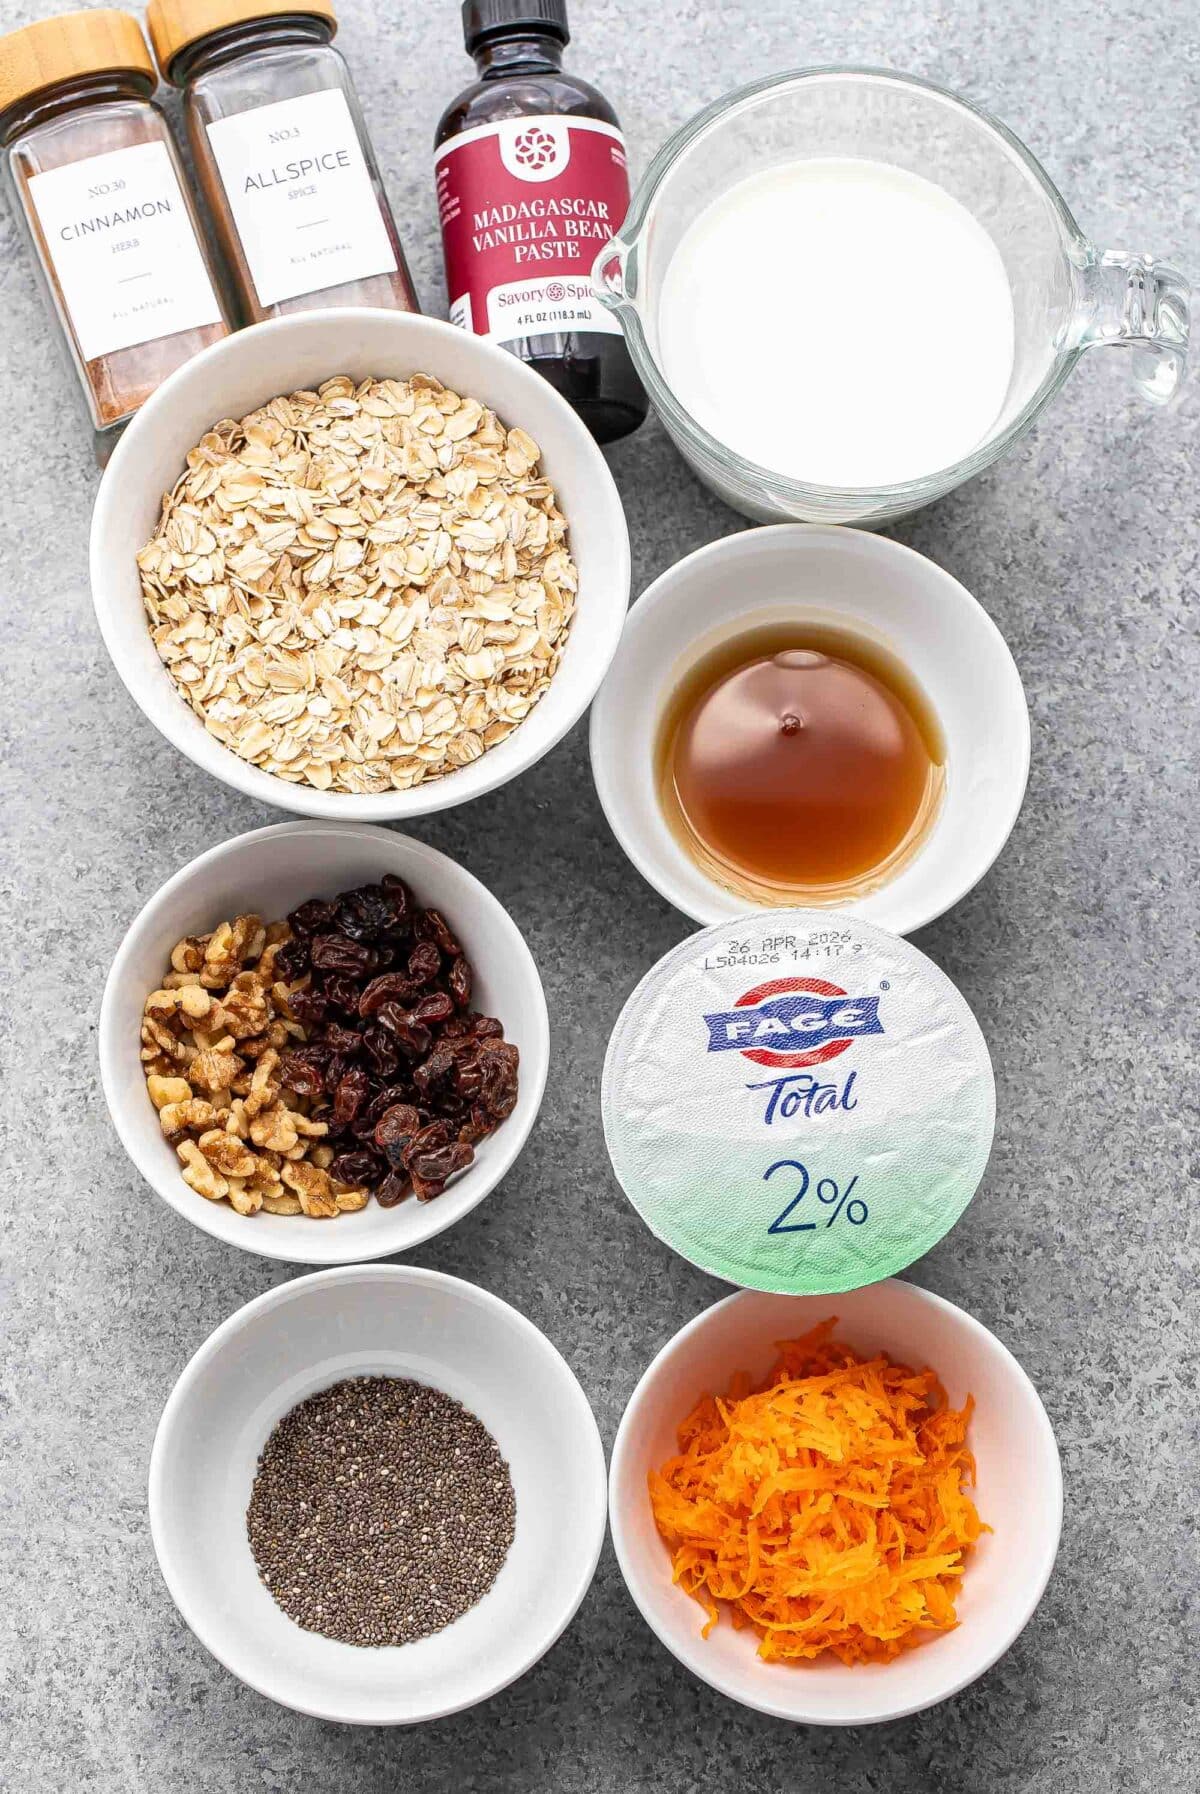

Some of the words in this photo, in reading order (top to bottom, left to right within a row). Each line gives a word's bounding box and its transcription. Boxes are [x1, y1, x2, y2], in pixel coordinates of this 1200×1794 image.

[268, 127, 301, 144] NO.3
[244, 150, 351, 193] ALLSPICE
[88, 179, 127, 198] NO.30
[287, 185, 318, 201] SPICE
[60, 199, 172, 241] CINNAMON
[473, 198, 609, 231] MADAGASCAR
[111, 238, 140, 253] HERB
[472, 220, 557, 252] VANILLA
[565, 220, 615, 240] BEAN
[513, 241, 580, 263] PASTE
[497, 288, 545, 308] Savory
[567, 283, 597, 301] Spic
[517, 315, 523, 325] 4
[525, 313, 534, 324] FL
[536, 310, 547, 322] OZ
[549, 309, 575, 321] (118.3
[577, 309, 592, 320] mL)
[728, 939, 751, 954] 26
[762, 935, 797, 951] APR
[808, 929, 852, 946] 2026
[704, 952, 781, 971] L504026
[792, 944, 844, 961] 14:17
[724, 1008, 867, 1041] FAGE
[745, 1071, 858, 1125] Total
[762, 1158, 869, 1235] 2%
